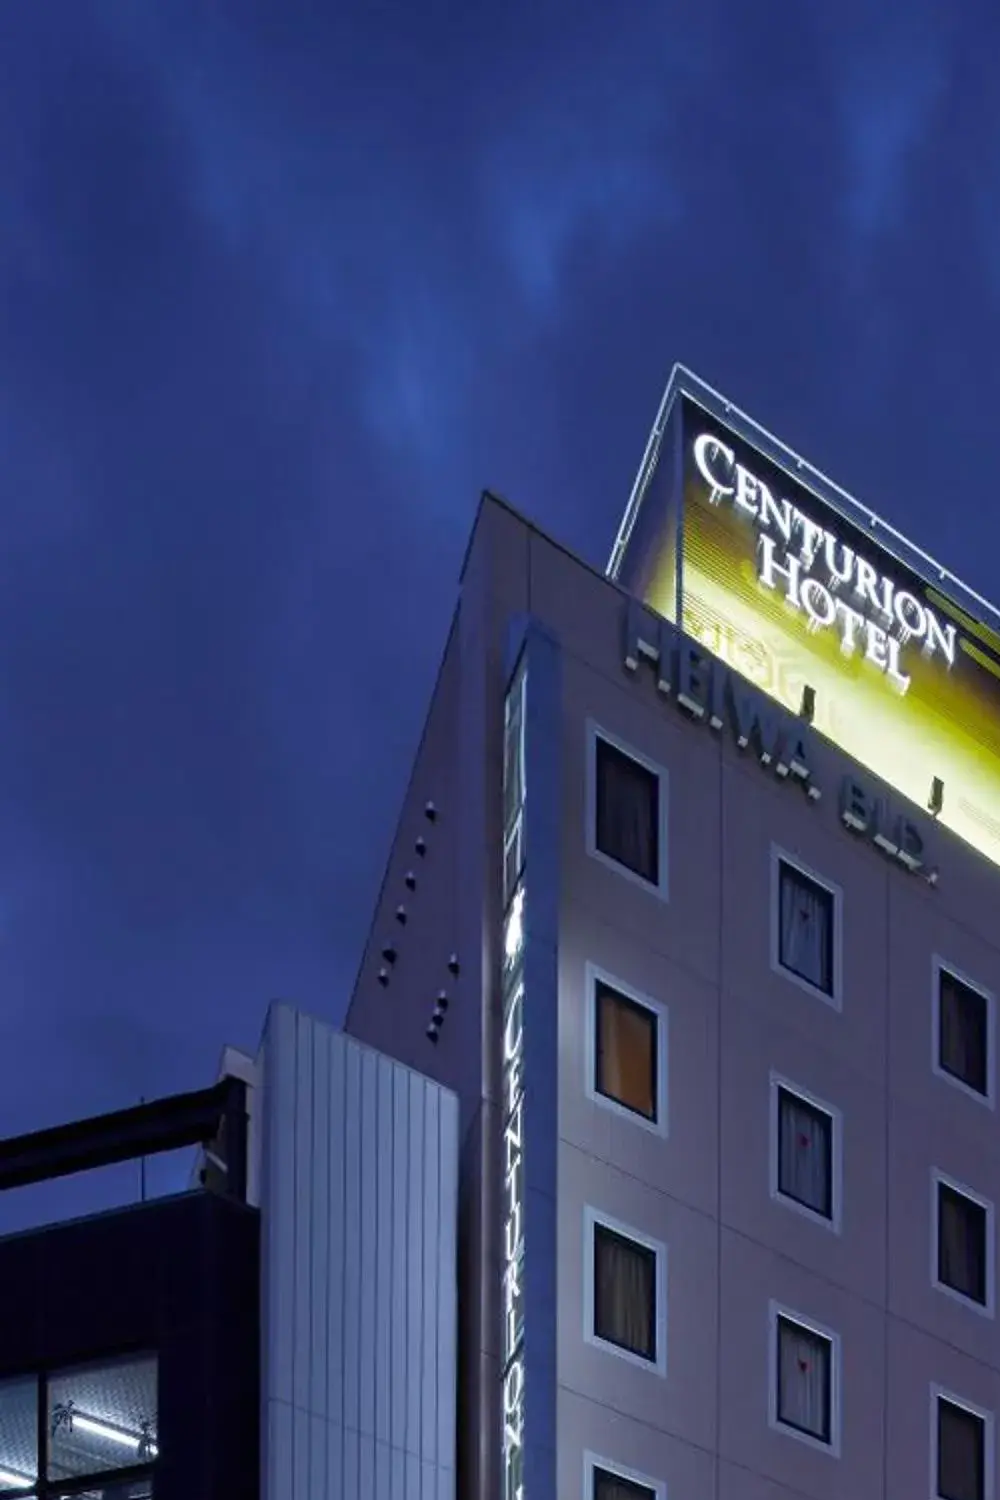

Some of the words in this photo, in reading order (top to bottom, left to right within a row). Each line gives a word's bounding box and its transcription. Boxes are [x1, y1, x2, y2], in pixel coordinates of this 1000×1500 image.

[693, 433, 957, 668] CENTURION
[758, 533, 911, 694] HOTEL
[624, 603, 823, 802] HEIWA
[502, 980, 526, 1462] CENTURION
